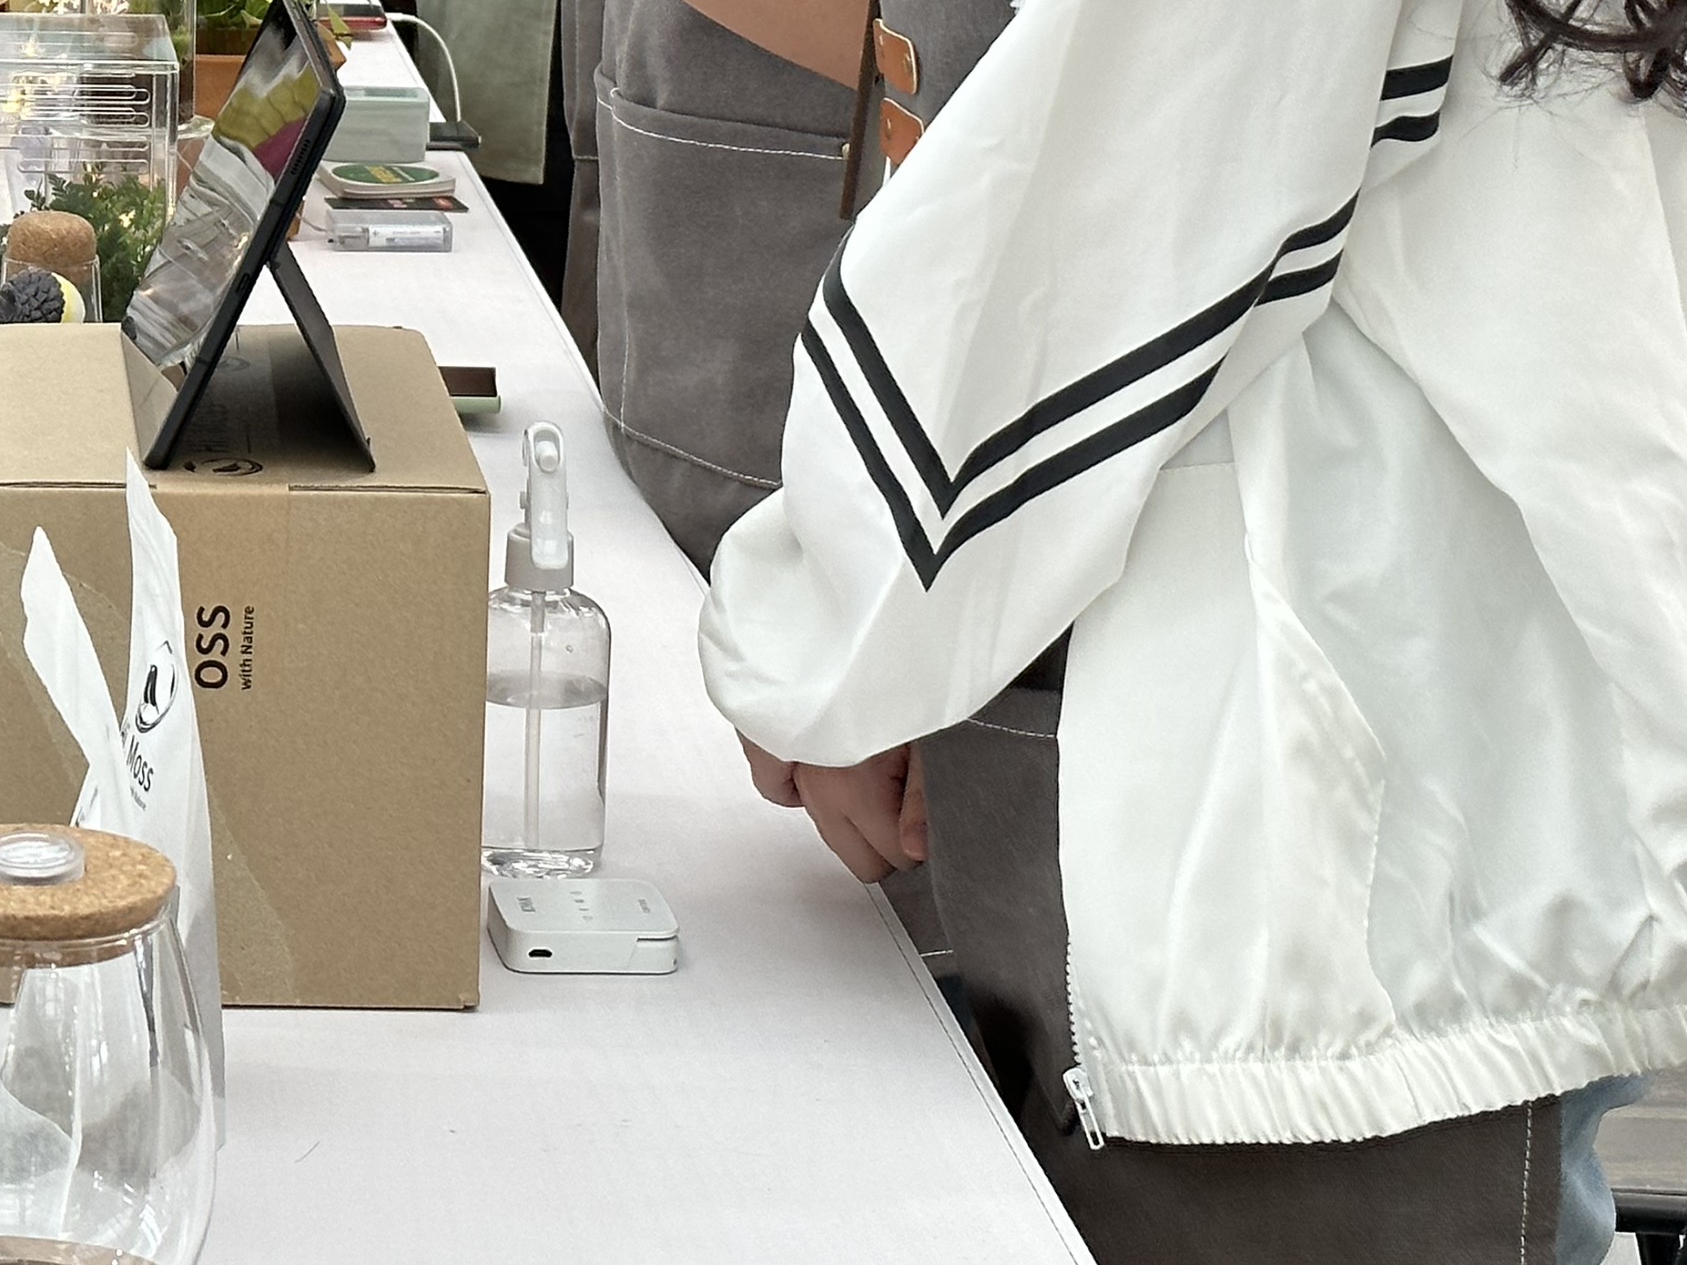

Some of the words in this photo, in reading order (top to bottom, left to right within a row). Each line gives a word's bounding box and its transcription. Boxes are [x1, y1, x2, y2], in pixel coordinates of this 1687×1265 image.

[194, 605, 231, 689] OSS
[240, 605, 255, 655] Nature
[239, 658, 253, 691] with
